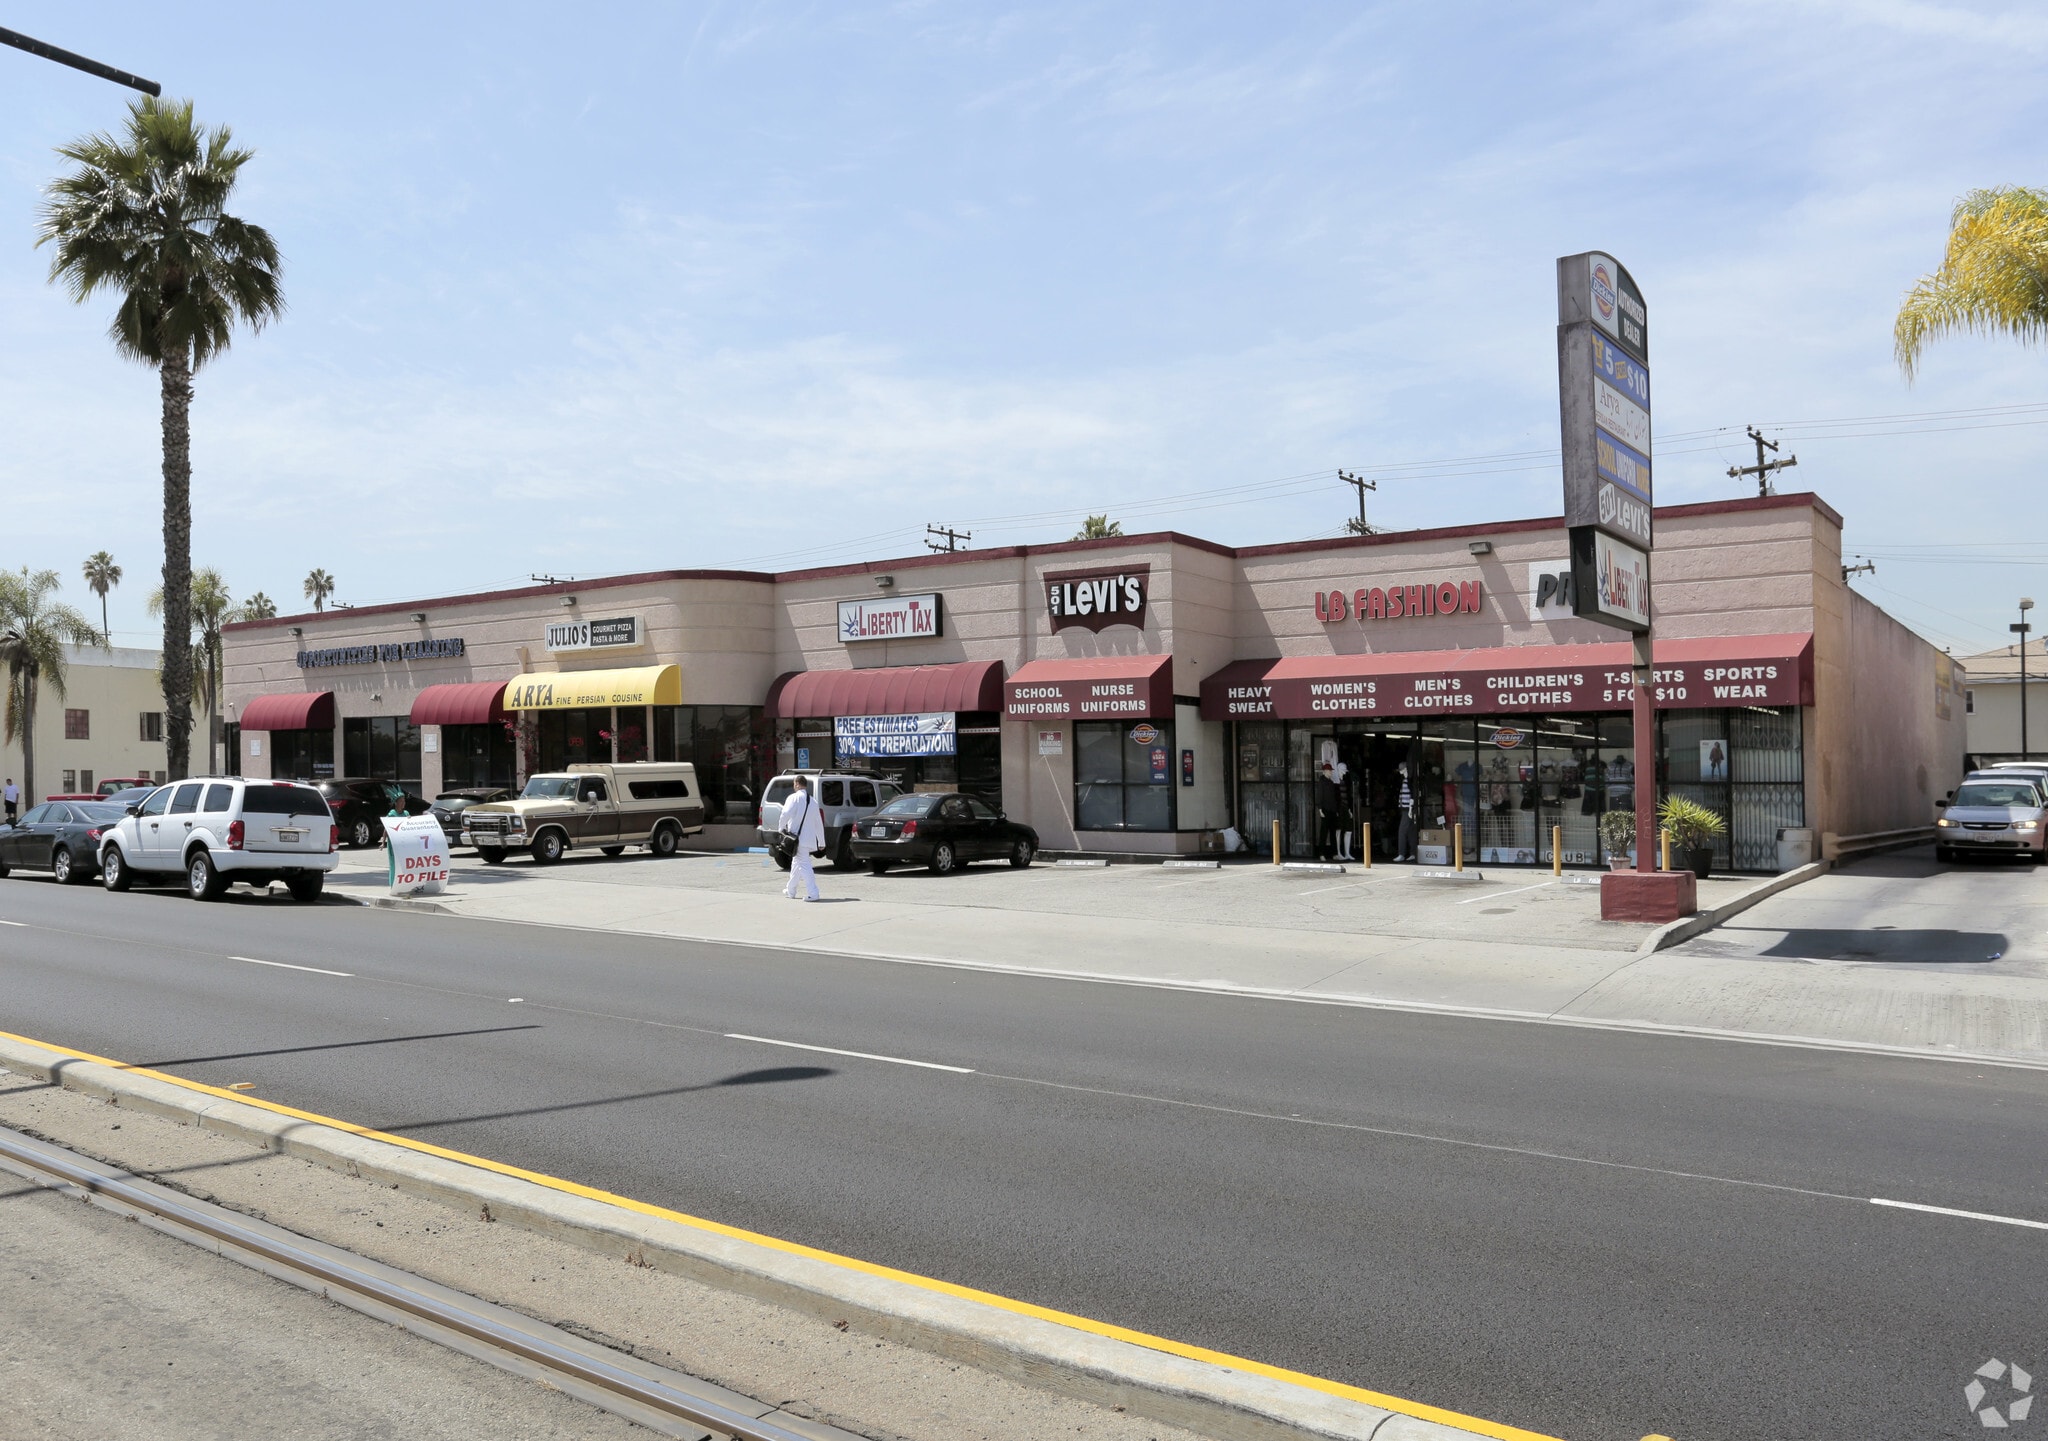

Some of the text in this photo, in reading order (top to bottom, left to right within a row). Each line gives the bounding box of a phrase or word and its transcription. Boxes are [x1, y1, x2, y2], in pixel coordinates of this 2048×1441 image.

[1618, 287, 1645, 326] AUTHORIZED
[1623, 317, 1641, 348] DEALER
[1605, 346, 1614, 375] 5
[1627, 364, 1647, 400] $10
[1600, 486, 1615, 521] 501
[1536, 572, 1573, 608] PR
[1050, 586, 1061, 615] 501
[1314, 580, 1483, 623] LB FASHION
[859, 601, 932, 636] LIBERTY TAX
[548, 625, 588, 647] JULIO'S
[592, 623, 632, 634] GOURMET PIZZA
[592, 636, 608, 644] PASTA
[613, 634, 628, 642] MORE
[297, 638, 462, 669] OPPORTUNITIES FOR LEARNING
[1310, 666, 1778, 696] WOMEN'S MEN'S CHILDREN'S T-SRTS SPORTS
[511, 684, 643, 708] ARYA FINE PERSIAN COUSINE
[1014, 684, 1134, 699] SCHOOL NURSE
[1228, 686, 1272, 699] HEAVY
[1312, 698, 1377, 710] CLOTHES
[1404, 694, 1474, 708] CLOTHES
[1498, 691, 1573, 706] CLOTHES
[1603, 690, 1613, 702] 5
[1656, 687, 1688, 701] $10
[1714, 685, 1768, 698] WEAR
[1008, 699, 1147, 716] UNIFORMS UNIFORMS
[1228, 702, 1274, 714] SWEAT
[837, 715, 920, 734] FREE ESTIMATES
[1133, 730, 1156, 738] Dickies
[838, 734, 954, 754] 30% OFF PREPARATION!
[1493, 734, 1522, 742] Dickies
[400, 824, 439, 832] Guaranteed
[420, 836, 430, 850] 7
[405, 855, 442, 870] DAYS
[1546, 852, 1584, 863] CUB
[398, 870, 448, 884] TO FILE
